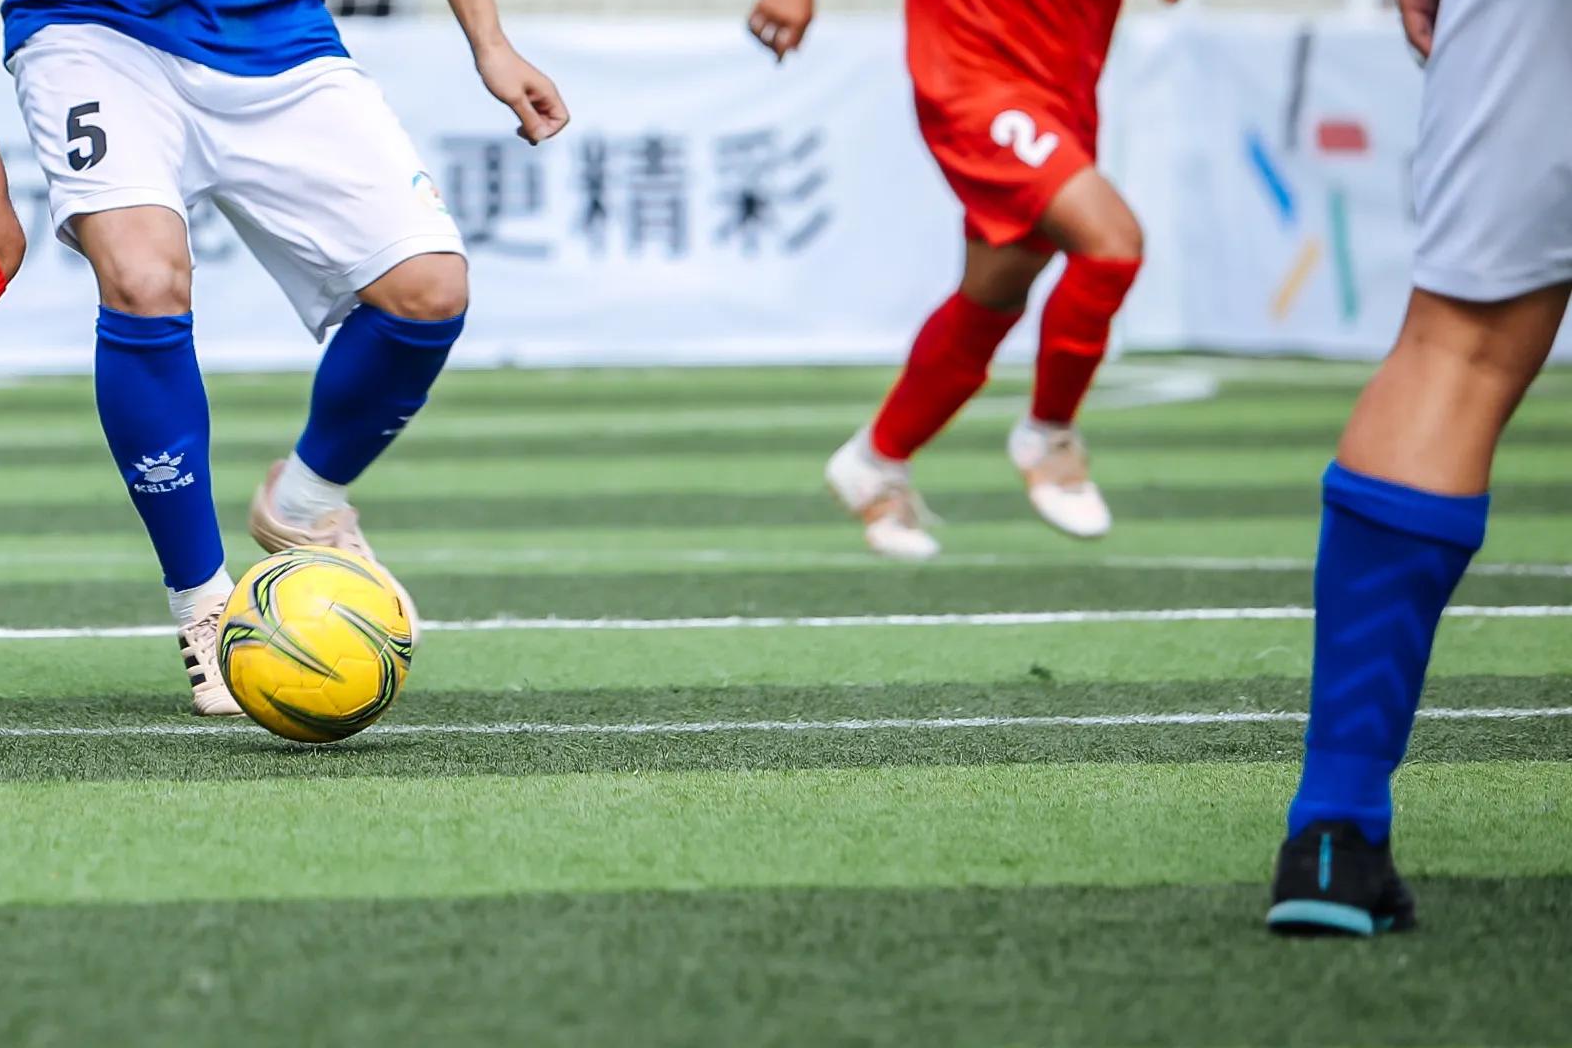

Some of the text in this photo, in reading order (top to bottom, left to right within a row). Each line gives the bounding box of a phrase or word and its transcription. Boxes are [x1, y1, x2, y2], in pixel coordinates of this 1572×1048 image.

[67, 101, 107, 171] 5
[989, 109, 1060, 169] 2
[134, 472, 194, 493] KELME
